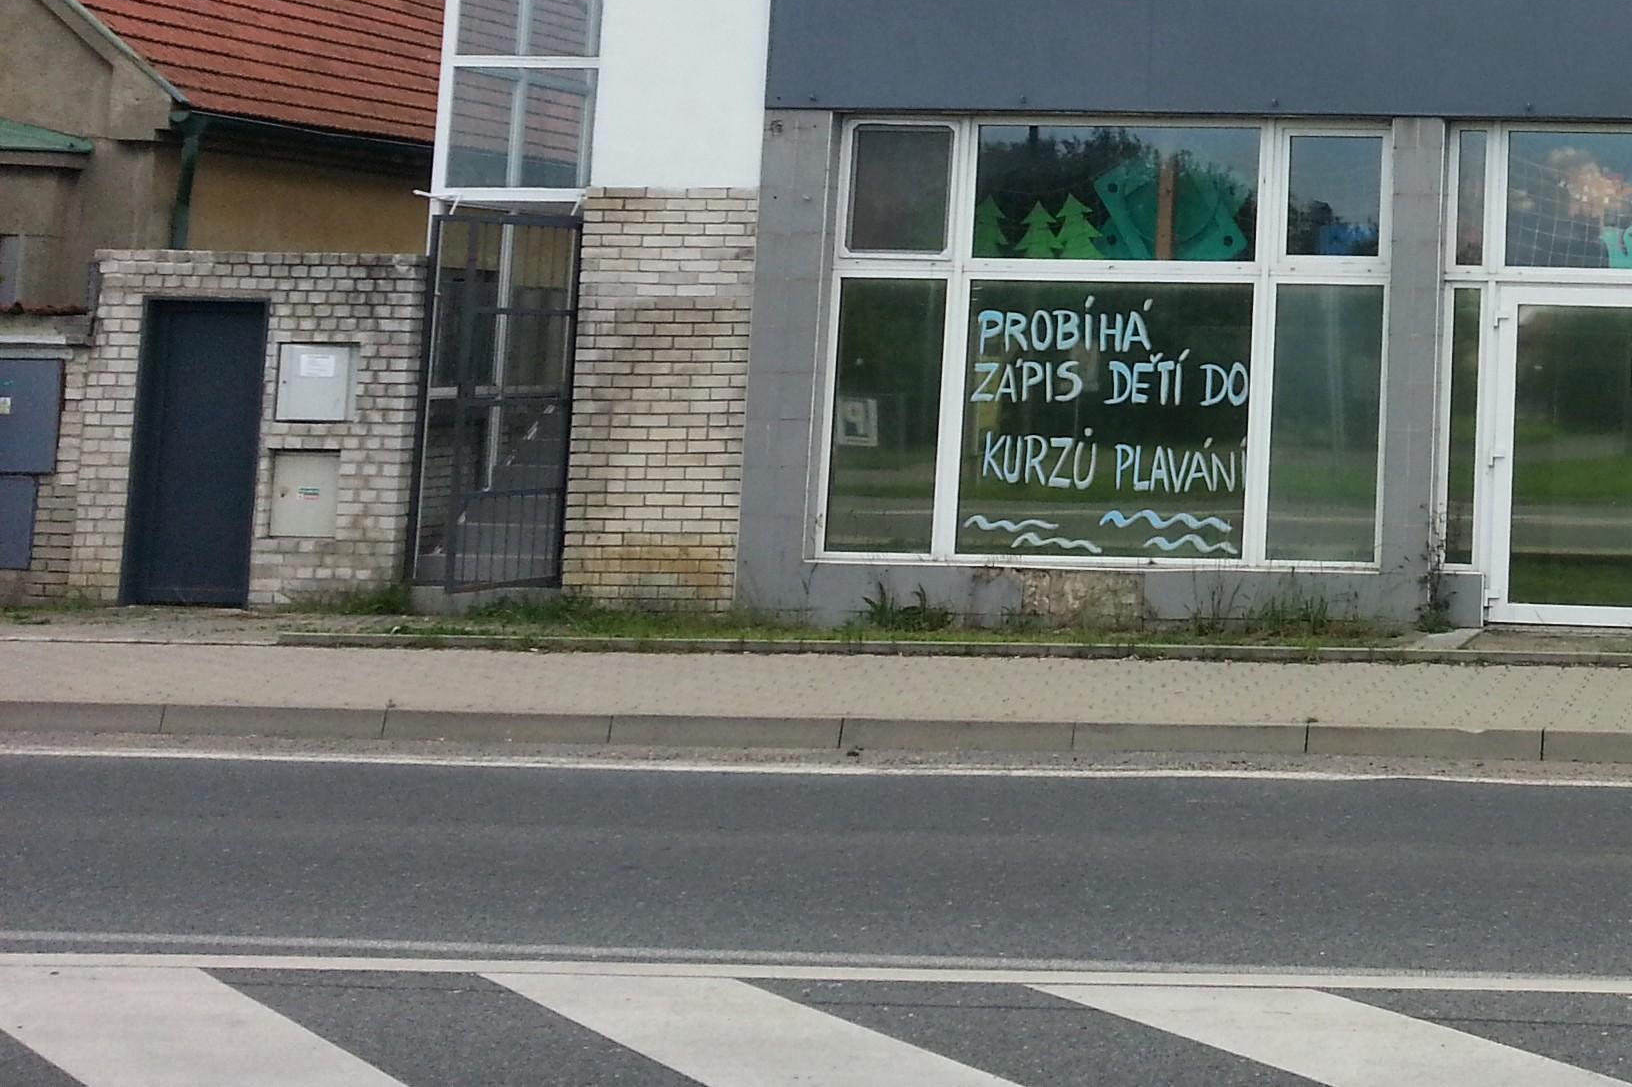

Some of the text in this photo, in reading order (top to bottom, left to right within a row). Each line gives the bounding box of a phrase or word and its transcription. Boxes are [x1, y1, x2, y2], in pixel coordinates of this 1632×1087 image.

[978, 295, 1153, 354] PROBÍHÁ
[970, 349, 1249, 407] ZÁPIS DĚTÍ DO
[982, 427, 1097, 490] KURZŮ
